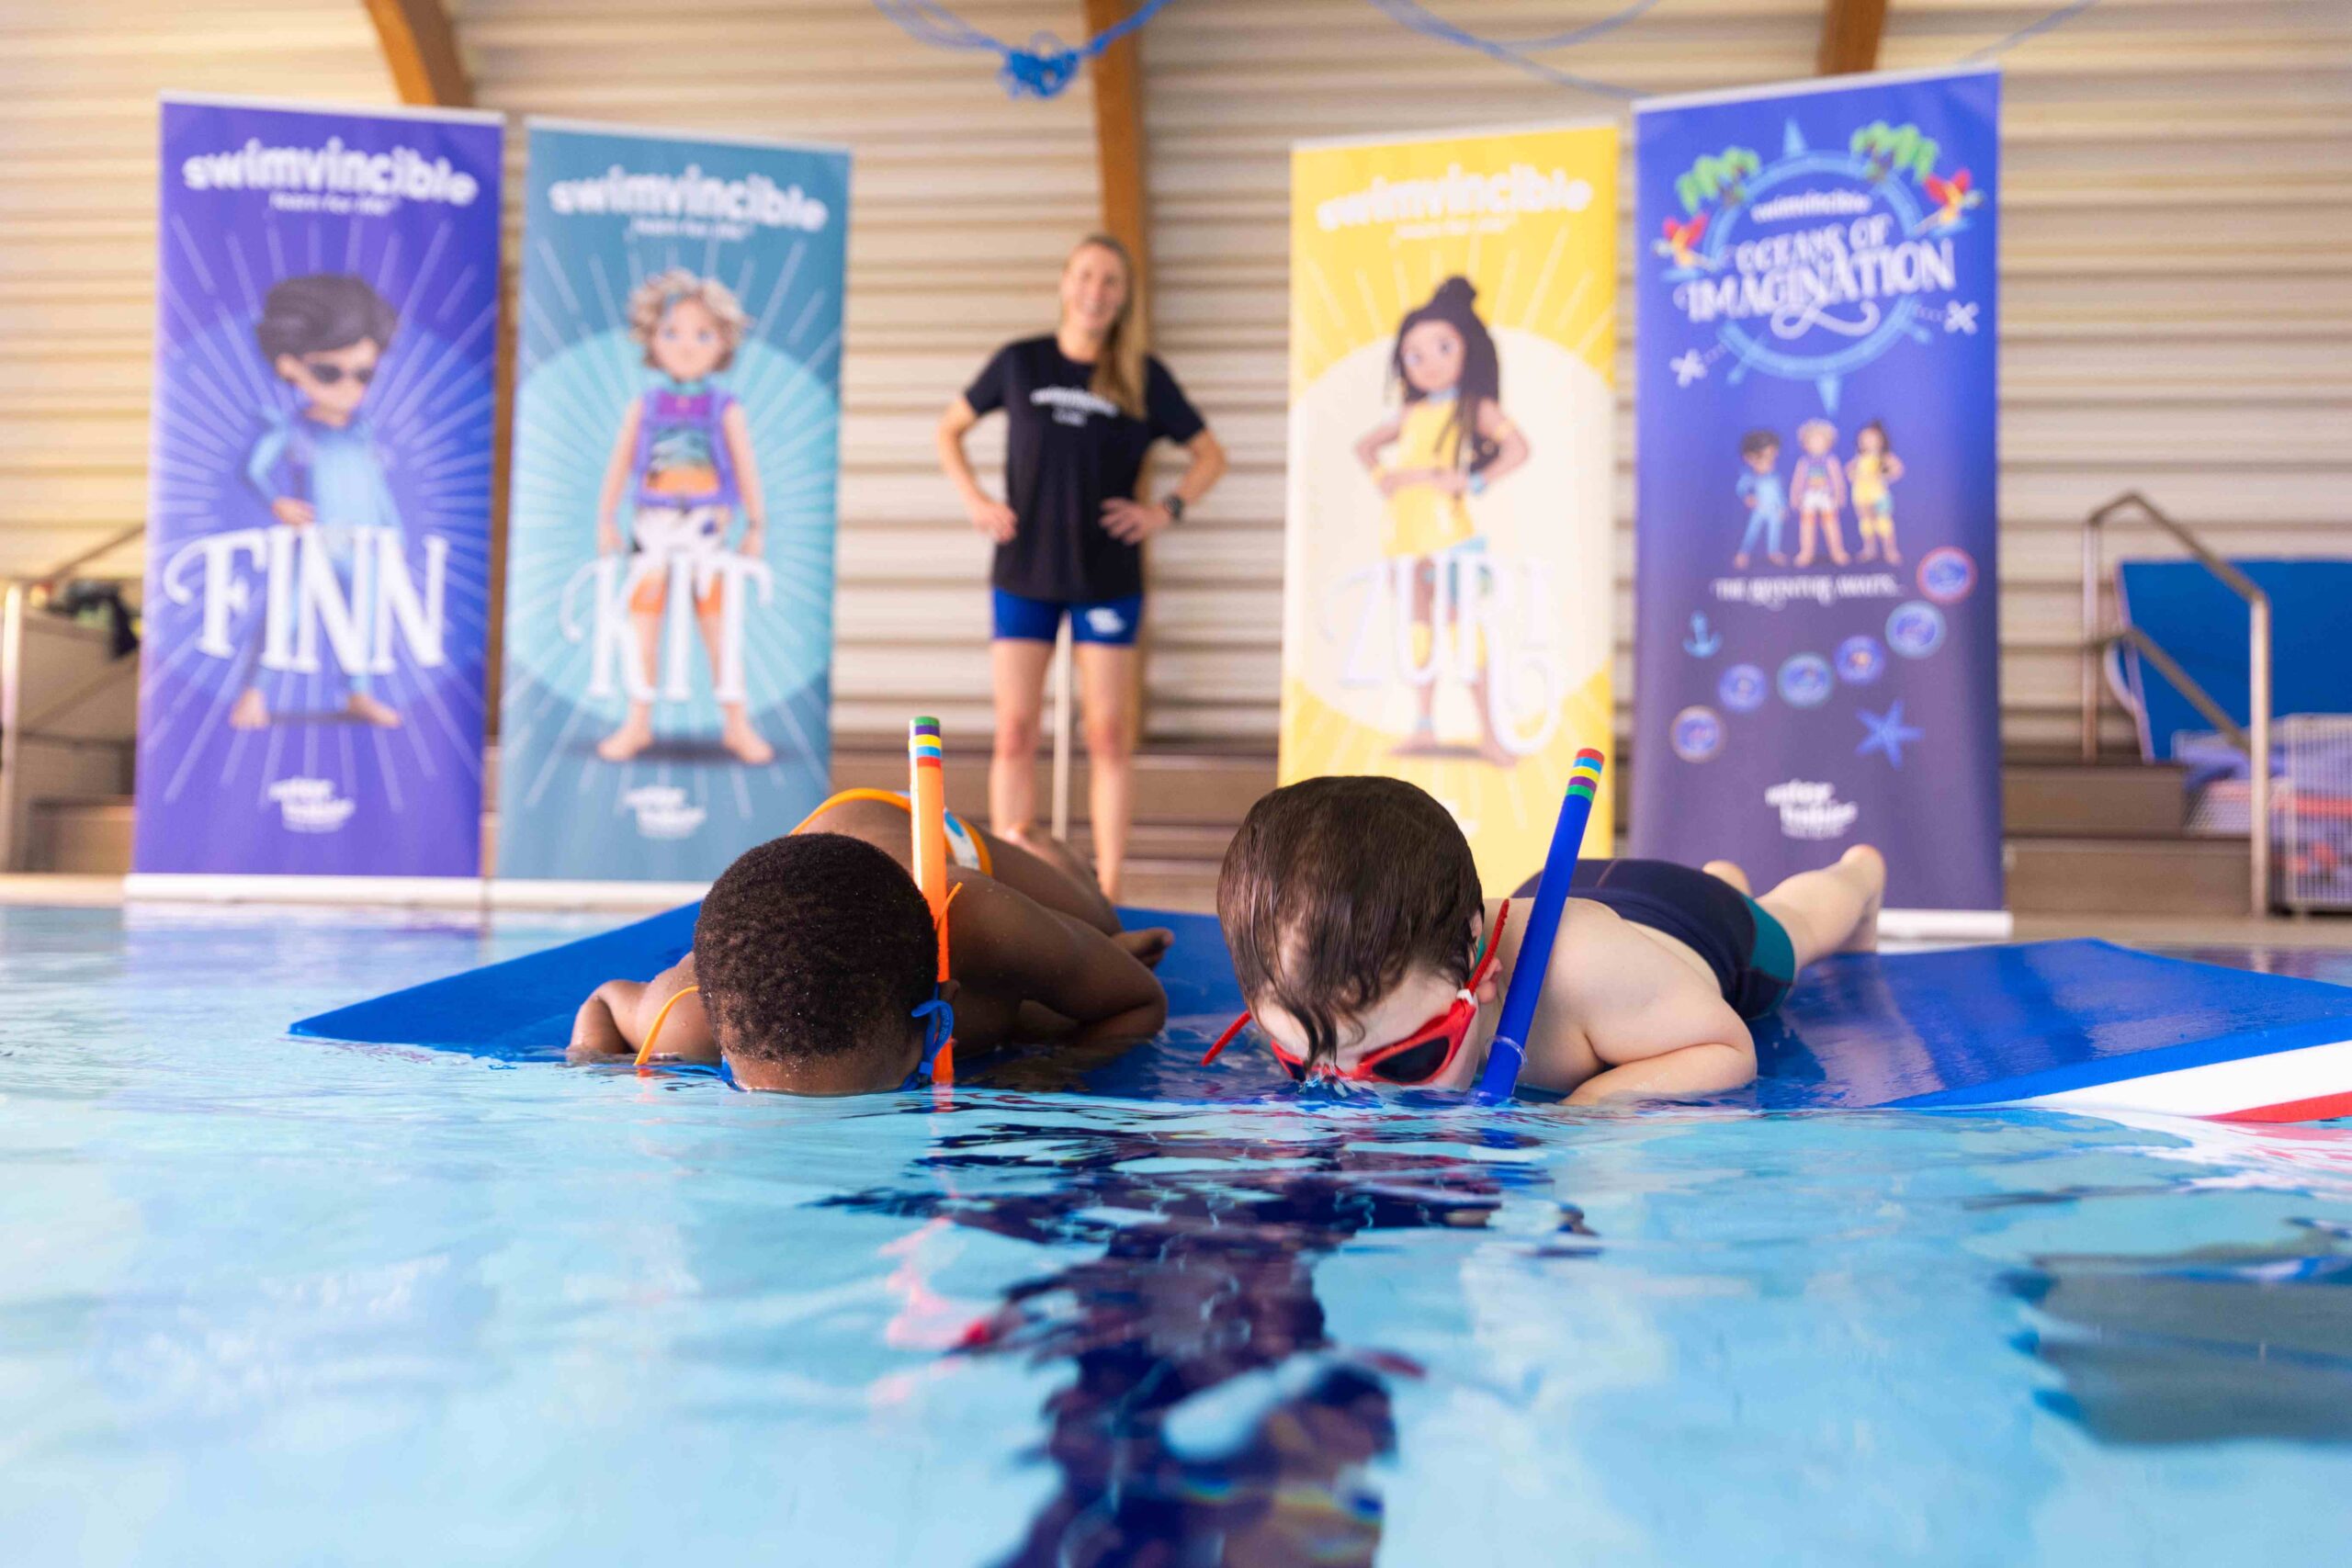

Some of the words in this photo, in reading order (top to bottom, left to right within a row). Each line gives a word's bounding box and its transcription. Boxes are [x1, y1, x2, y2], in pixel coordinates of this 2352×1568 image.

[183, 137, 480, 207] swimvincible
[549, 164, 829, 231] swimvincible
[1317, 163, 1594, 231] swimvincible
[1722, 223, 1848, 274] OCEANS
[1848, 213, 1894, 248] OF
[1672, 238, 1956, 340] IMAGINATION
[163, 524, 449, 675] FINN
[559, 549, 773, 702] KIT
[1323, 549, 1559, 755] ZURI
